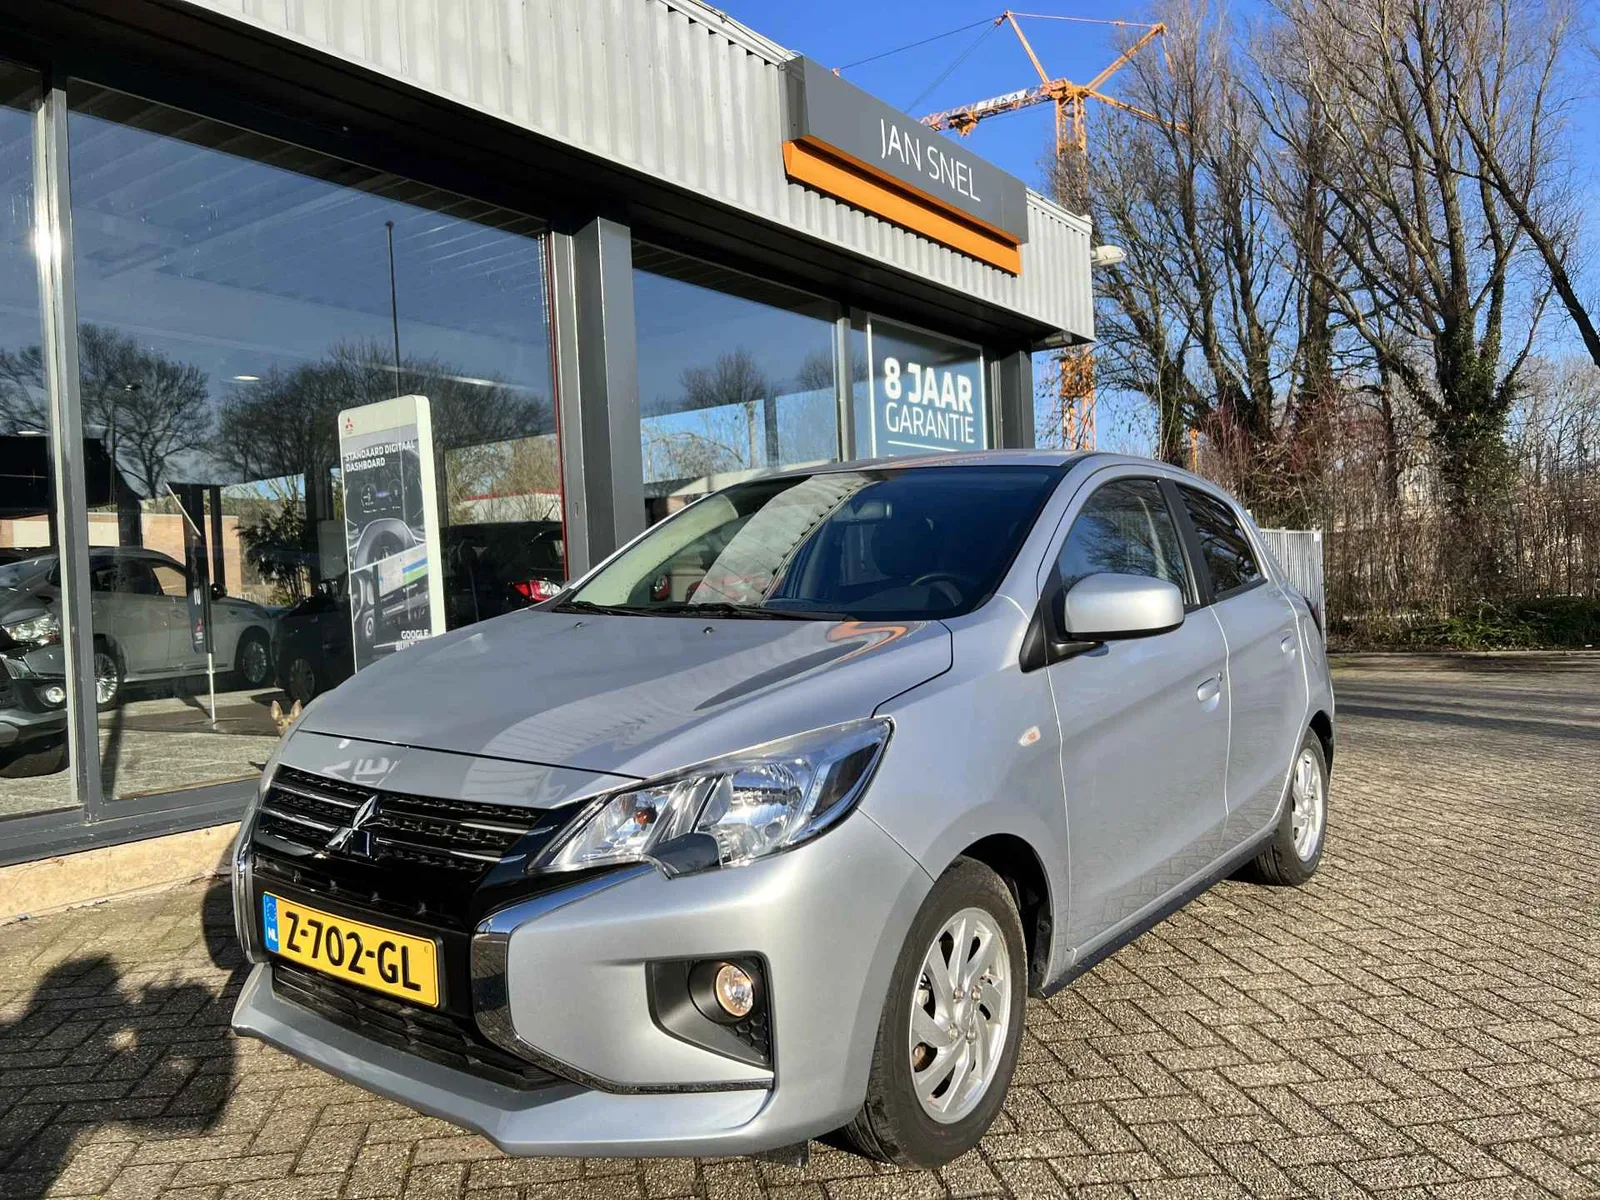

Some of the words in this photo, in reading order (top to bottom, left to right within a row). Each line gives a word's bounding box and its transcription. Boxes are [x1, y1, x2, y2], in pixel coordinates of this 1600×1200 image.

[880, 118, 921, 172] JAN
[927, 146, 981, 202] SNEL
[884, 357, 902, 400] 8
[907, 362, 974, 414] JAAR
[885, 402, 976, 444] GARANTIE
[345, 446, 384, 462] STANDAARD
[384, 440, 415, 454] DIGITAAL
[345, 457, 386, 473] DASHBOARD
[401, 629, 429, 640] GOOGLE
[267, 926, 278, 942] NL
[285, 911, 422, 992] Z-702-GL
